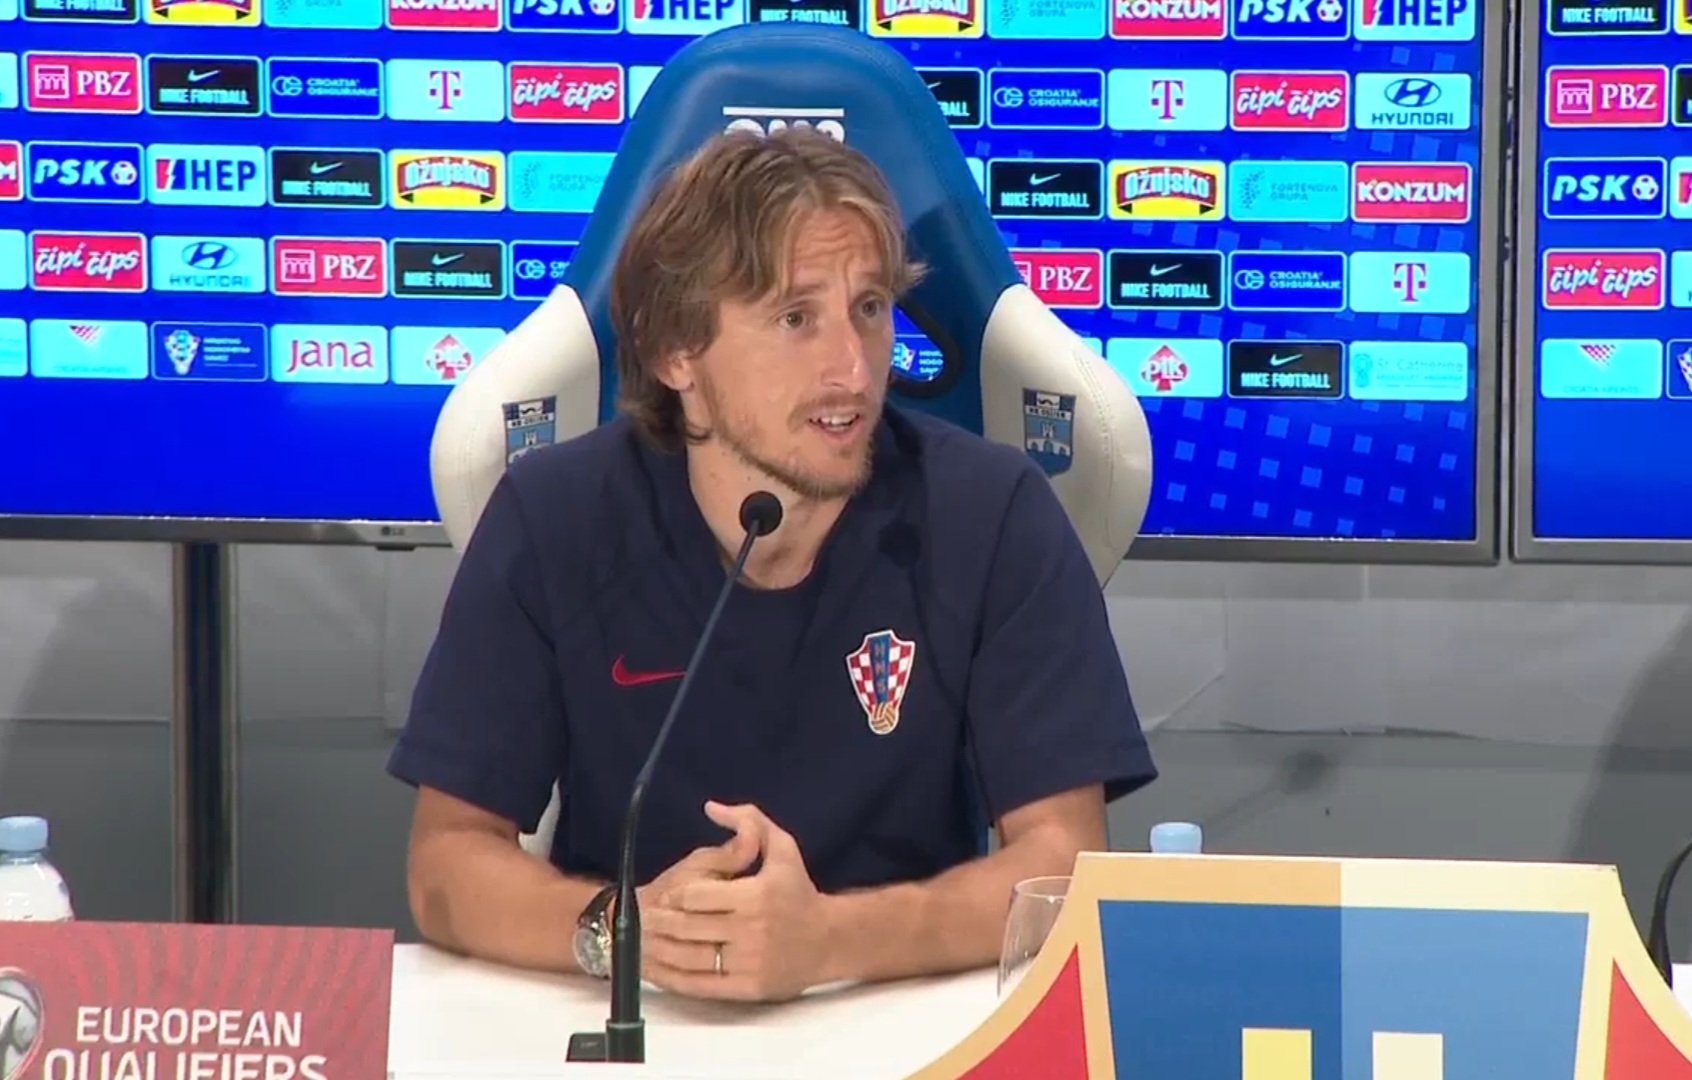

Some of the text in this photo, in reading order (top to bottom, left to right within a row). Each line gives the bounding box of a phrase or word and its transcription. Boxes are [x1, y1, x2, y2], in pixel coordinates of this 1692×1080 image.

[668, 0, 732, 21] HEP
[760, 8, 849, 25] NIKE FOOTBALL
[1115, 0, 1222, 20] KONZUM
[1238, 0, 1312, 23] PSK
[1399, 0, 1468, 27] HEP
[1562, 7, 1658, 24] NIKE FOOTBALL
[76, 70, 132, 97] PBZ
[1027, 88, 1078, 99] CROATIA
[1027, 98, 1100, 109] OSIGURANJE
[1600, 82, 1659, 111] PBZ
[1371, 111, 1454, 126] HYUNDAI
[33, 158, 110, 187] PSK
[190, 158, 257, 192] HEP
[1122, 170, 1211, 199] Ožujsko
[1357, 180, 1465, 203] KONZUM
[1551, 174, 1631, 202] PSK
[1000, 191, 1091, 209] NIKE FOOTBALL
[322, 253, 378, 281] PBZ
[1038, 265, 1094, 292] PBZ
[1269, 271, 1318, 282] CROATIA
[1120, 282, 1211, 300] NIKE FOOTBALL
[1269, 280, 1342, 291] OSIGURANJE
[1240, 372, 1332, 390] NIKE FOOTBALL
[76, 1006, 301, 1048] EUROPEAN
[44, 1048, 328, 1080] QUALIFIERS
